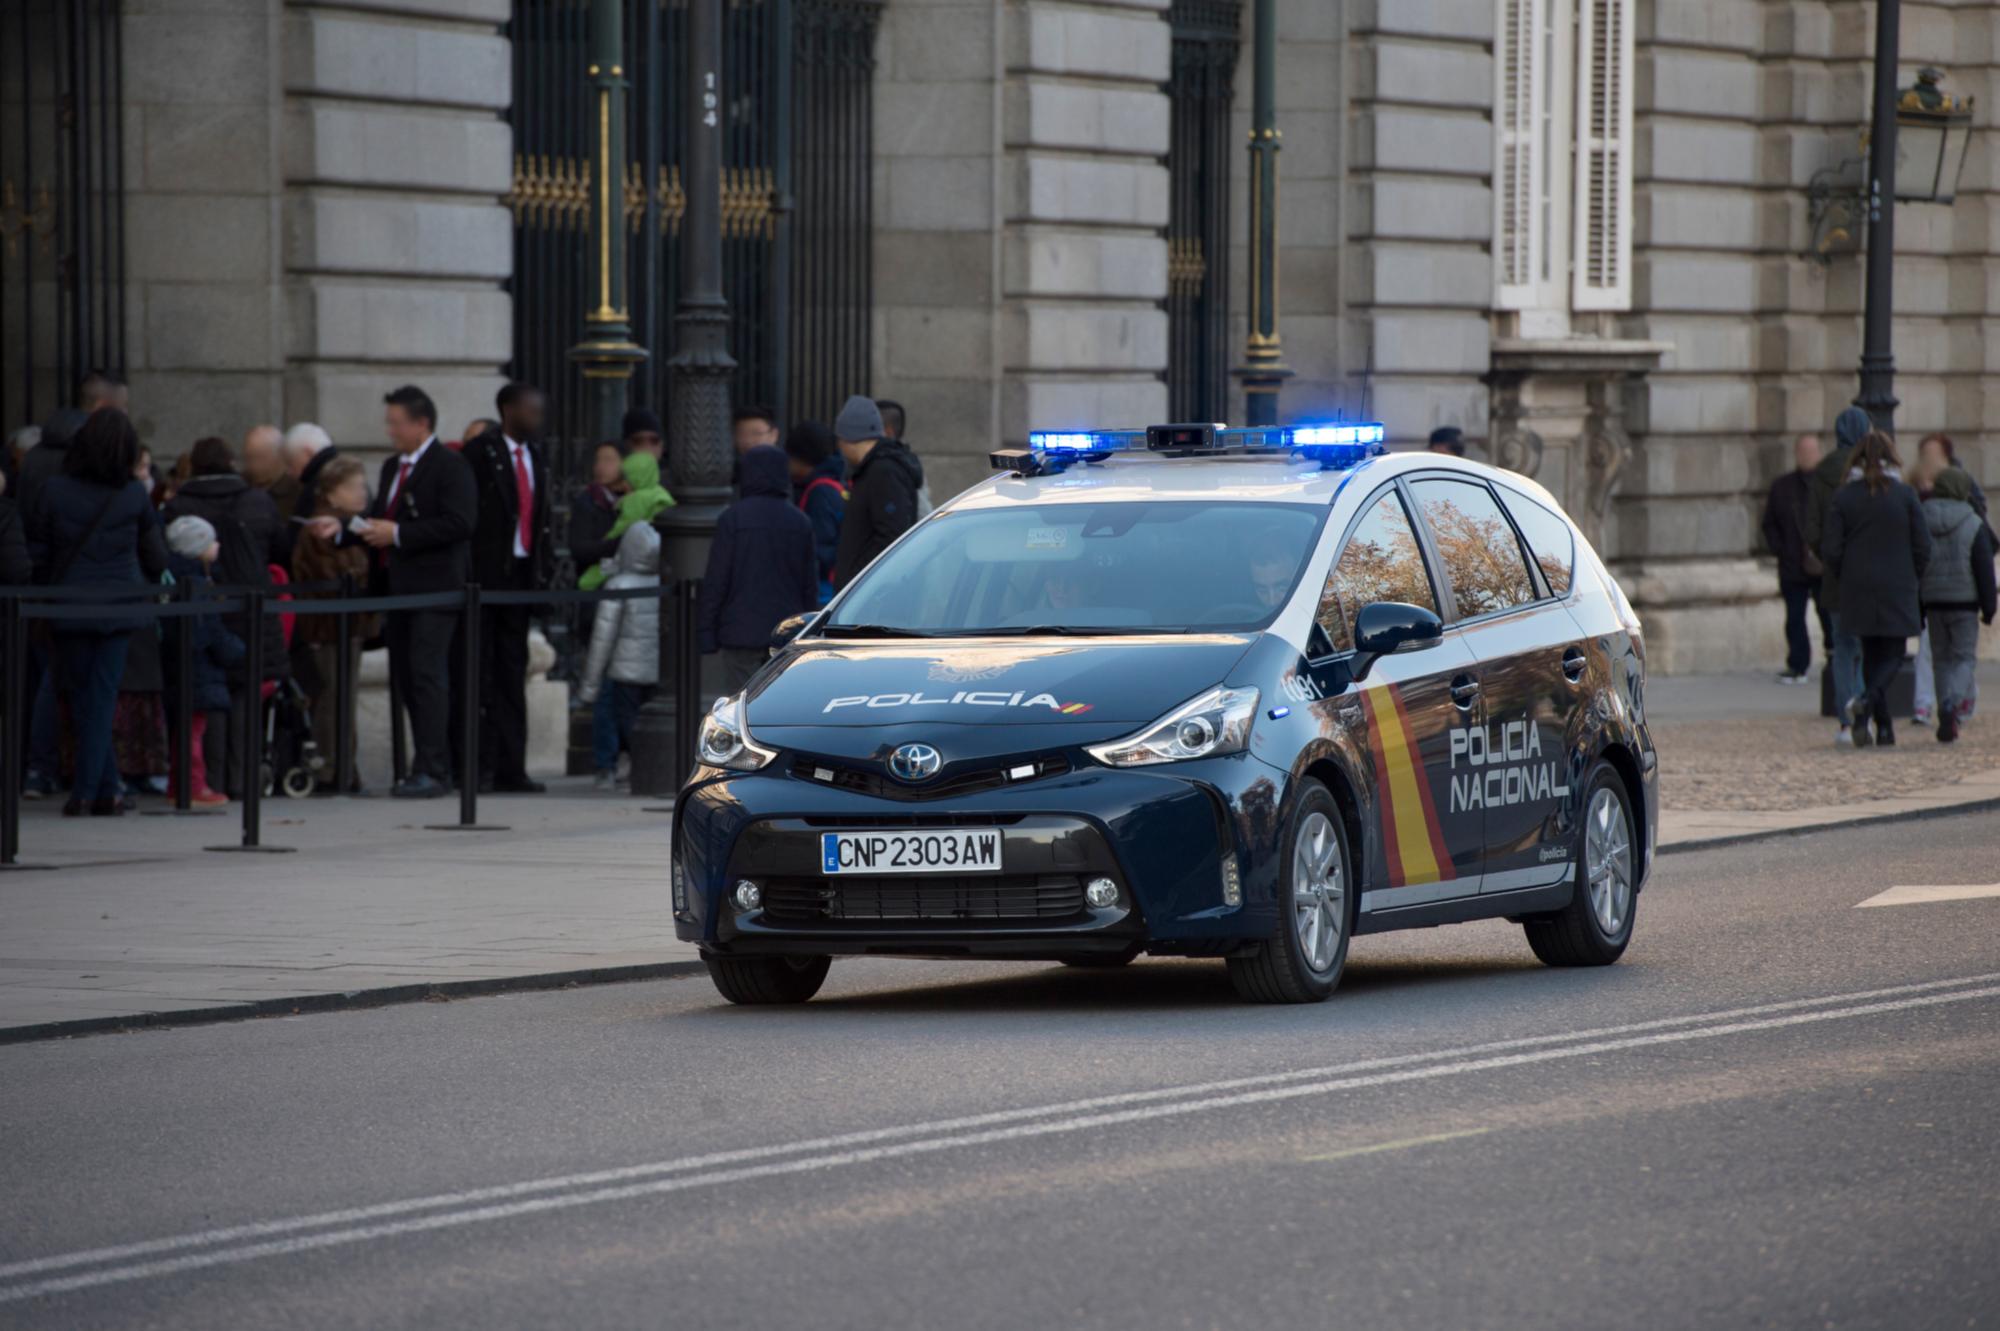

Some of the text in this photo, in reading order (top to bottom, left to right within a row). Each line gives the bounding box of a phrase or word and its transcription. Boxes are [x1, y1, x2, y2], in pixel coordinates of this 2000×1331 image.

[1450, 711, 1542, 769] POLICÍA
[1450, 761, 1570, 813] NACIONAL
[828, 857, 835, 866] E
